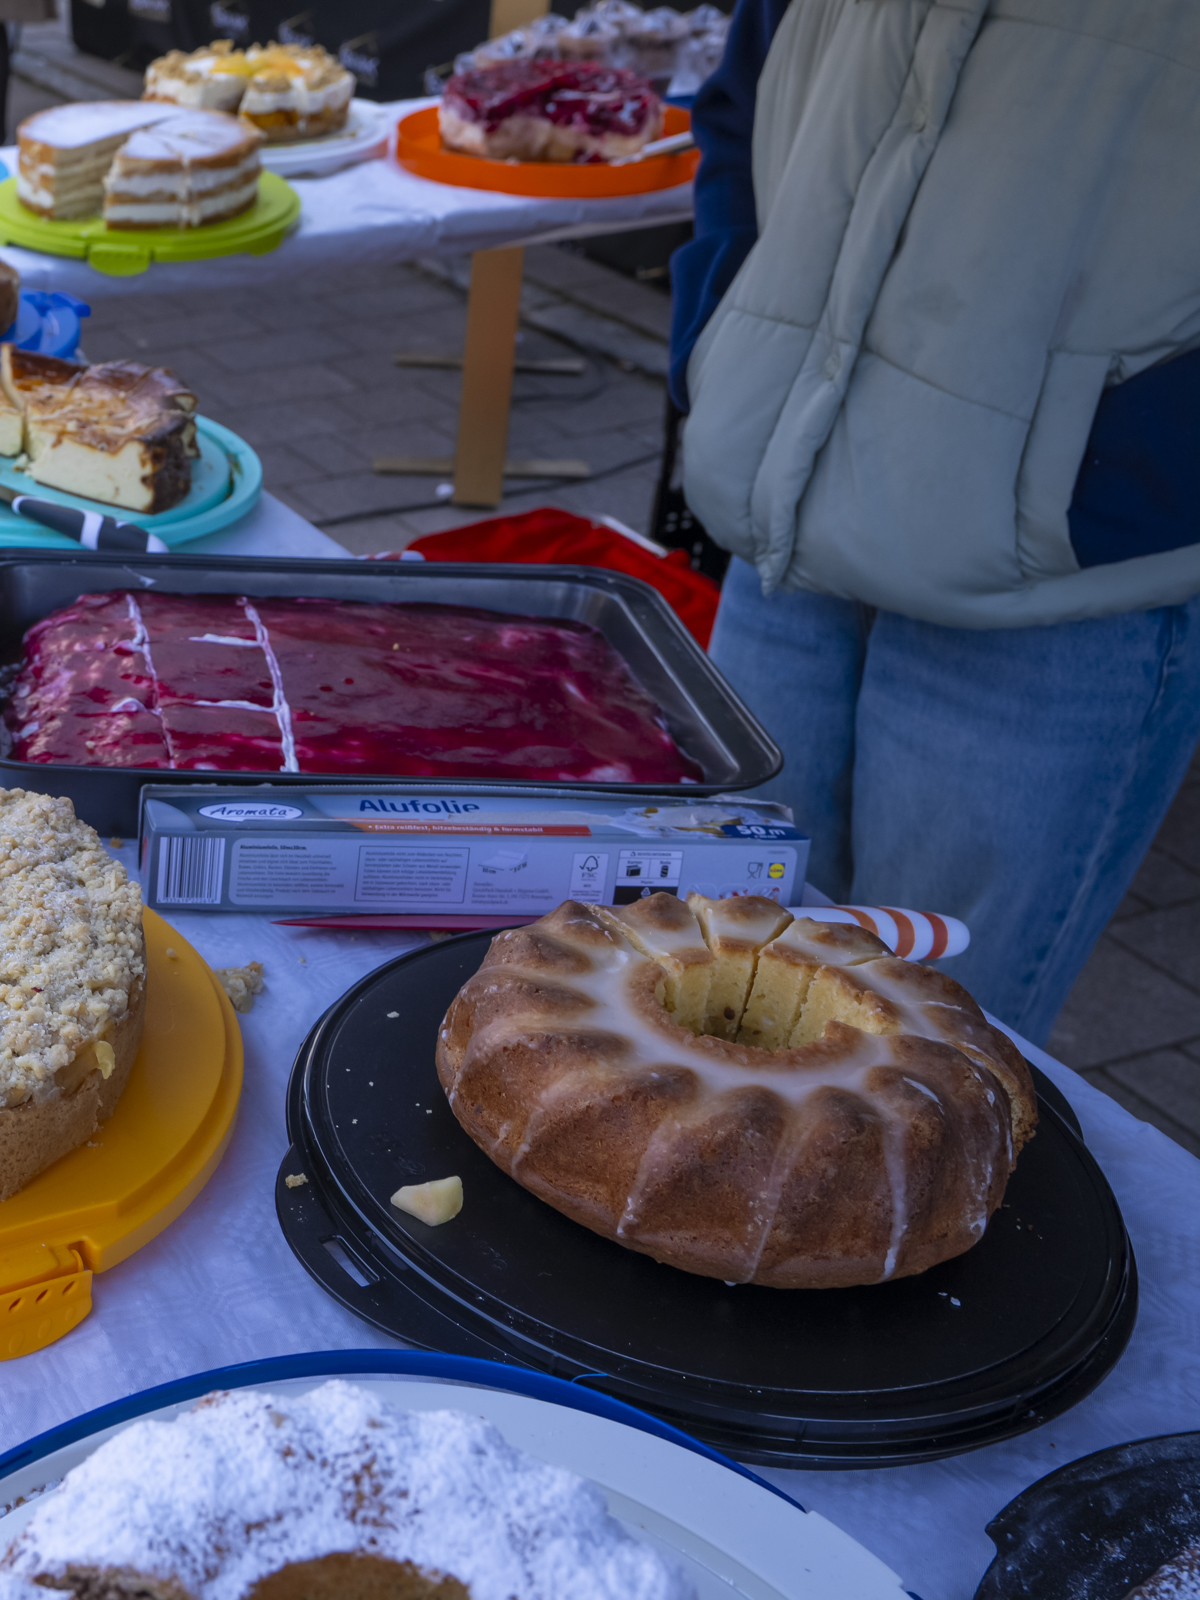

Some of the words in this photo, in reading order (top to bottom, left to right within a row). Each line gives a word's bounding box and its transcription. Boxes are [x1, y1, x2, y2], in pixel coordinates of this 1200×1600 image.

[210, 806, 287, 816] Aromata
[359, 799, 481, 813] Alufolie
[736, 825, 766, 835] 50
